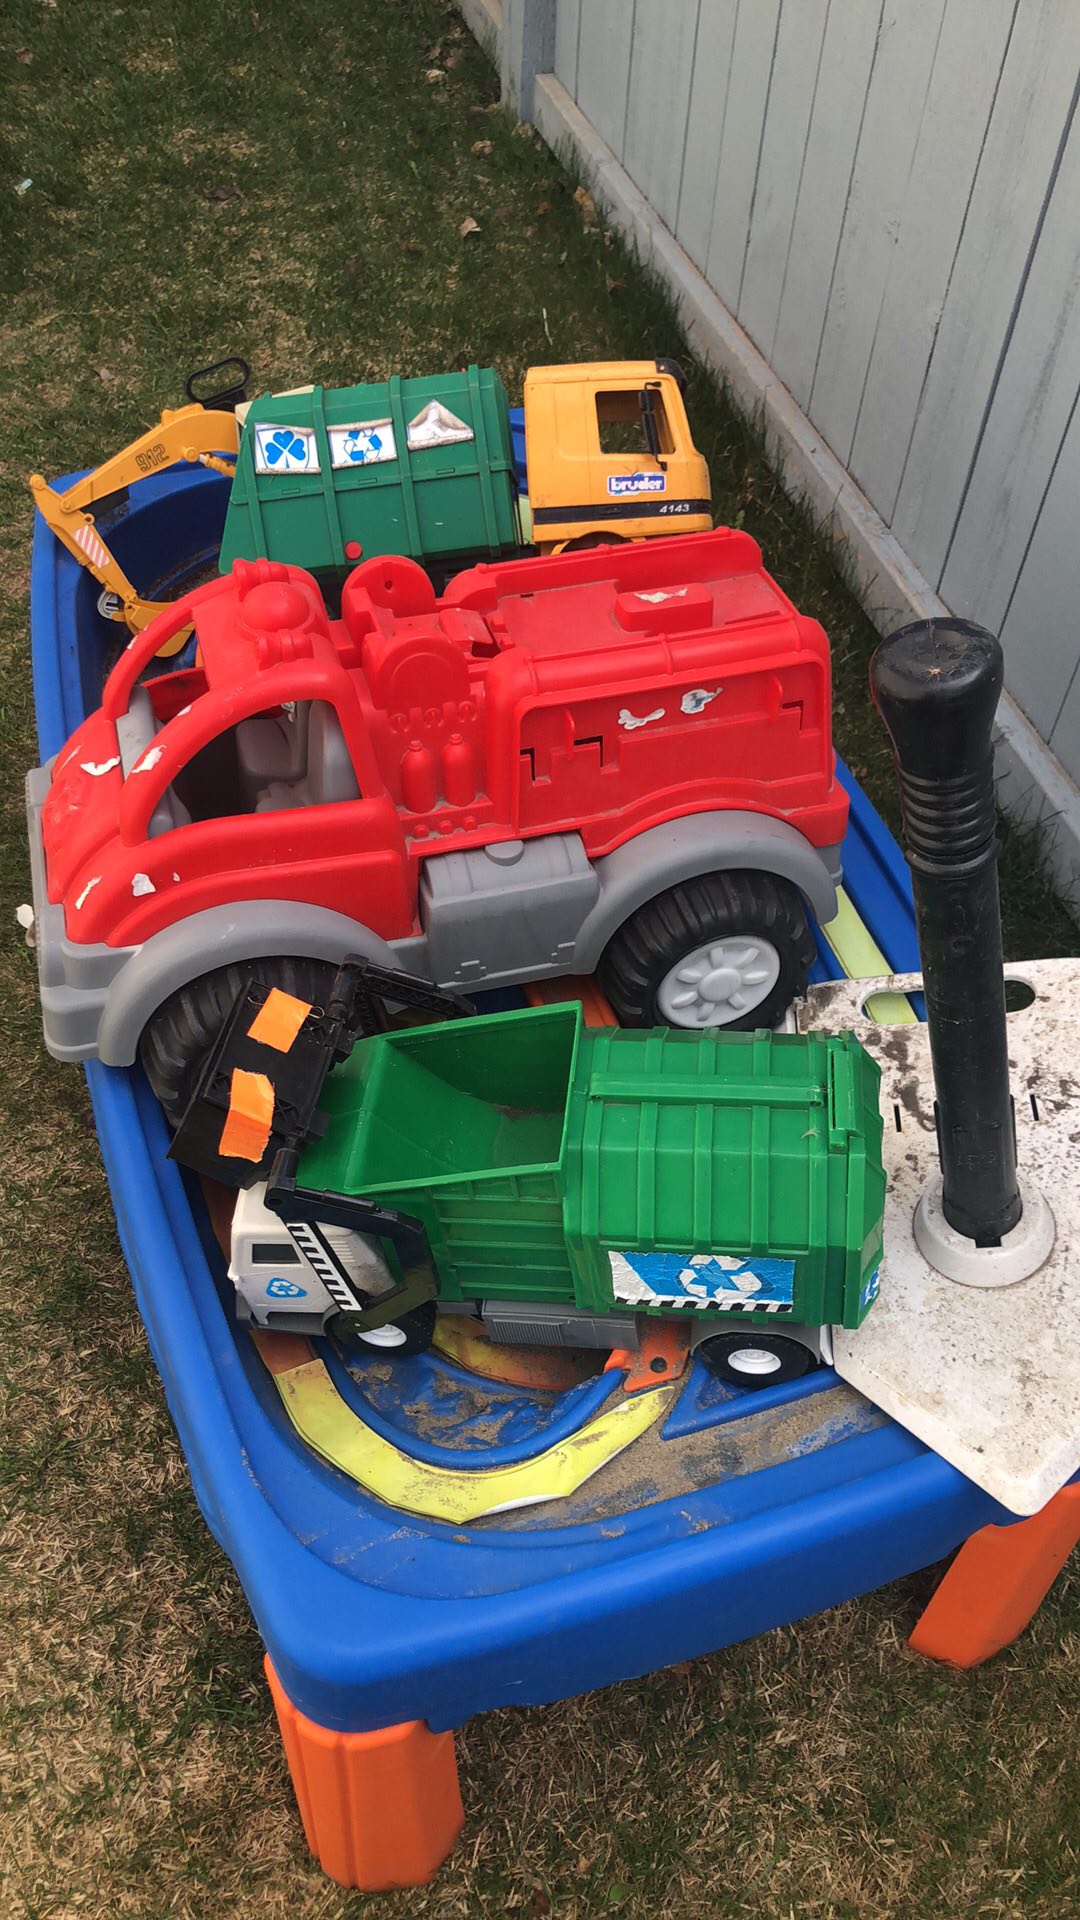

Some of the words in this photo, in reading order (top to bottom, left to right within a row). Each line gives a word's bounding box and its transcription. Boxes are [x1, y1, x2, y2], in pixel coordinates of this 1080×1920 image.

[135, 443, 169, 472] 912
[610, 477, 663, 491] bruder
[659, 503, 690, 513] 4143
